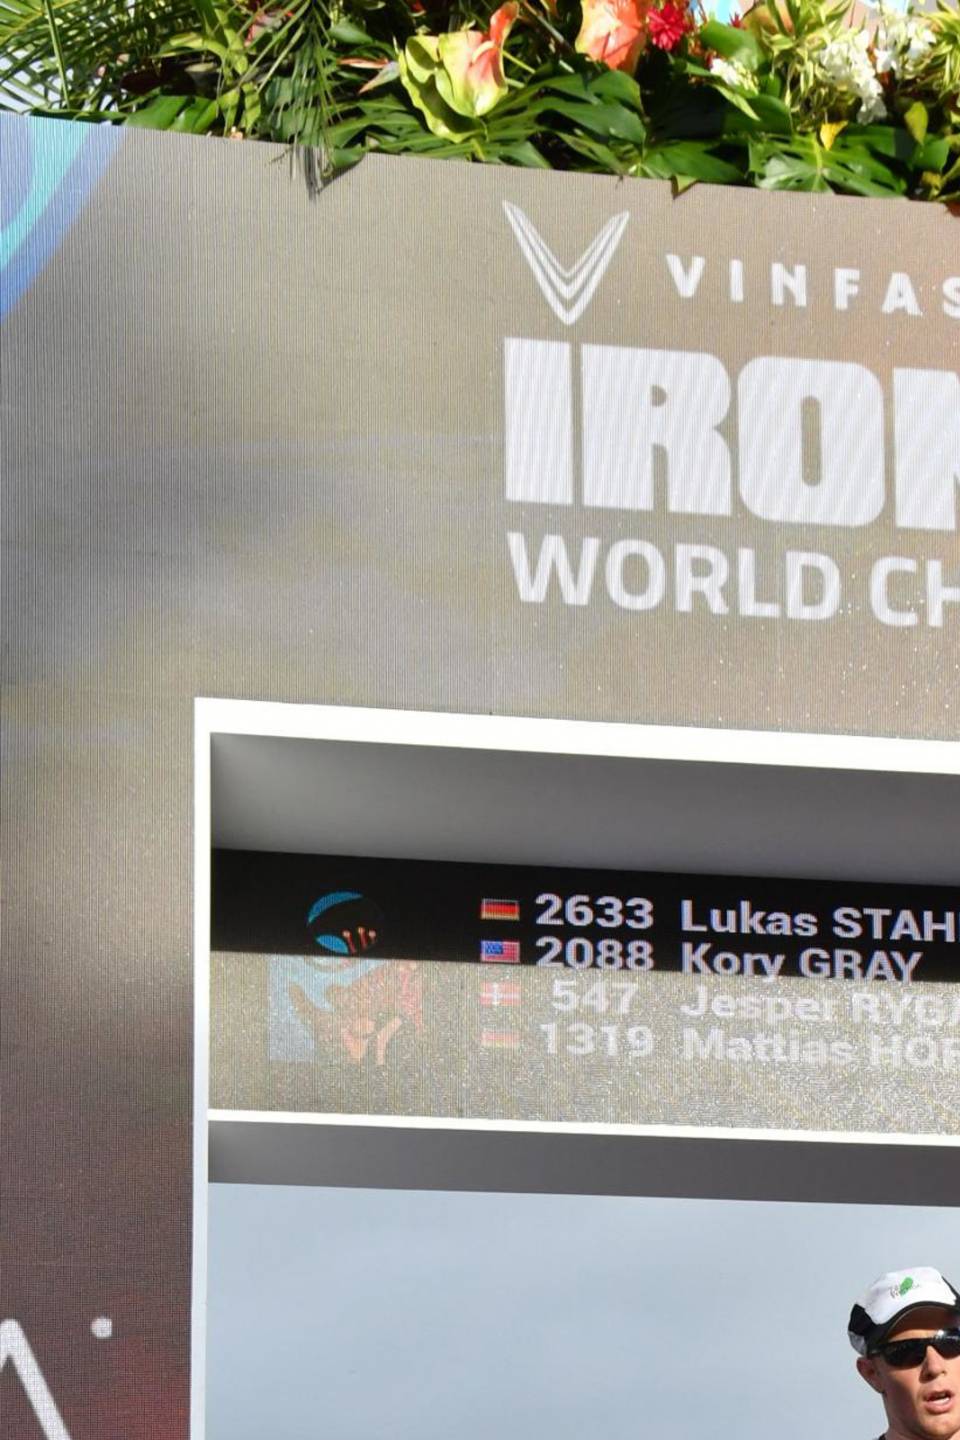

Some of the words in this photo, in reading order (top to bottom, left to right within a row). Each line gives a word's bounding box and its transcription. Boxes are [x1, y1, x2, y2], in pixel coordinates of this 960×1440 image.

[507, 531, 840, 620] WORLD
[535, 893, 654, 930] 2633
[681, 899, 818, 937] Lukas
[535, 935, 655, 972] 2088
[681, 941, 786, 982] Kory
[799, 948, 923, 985] GRAY
[552, 978, 638, 1014] 547
[540, 1021, 654, 1059] 1319
